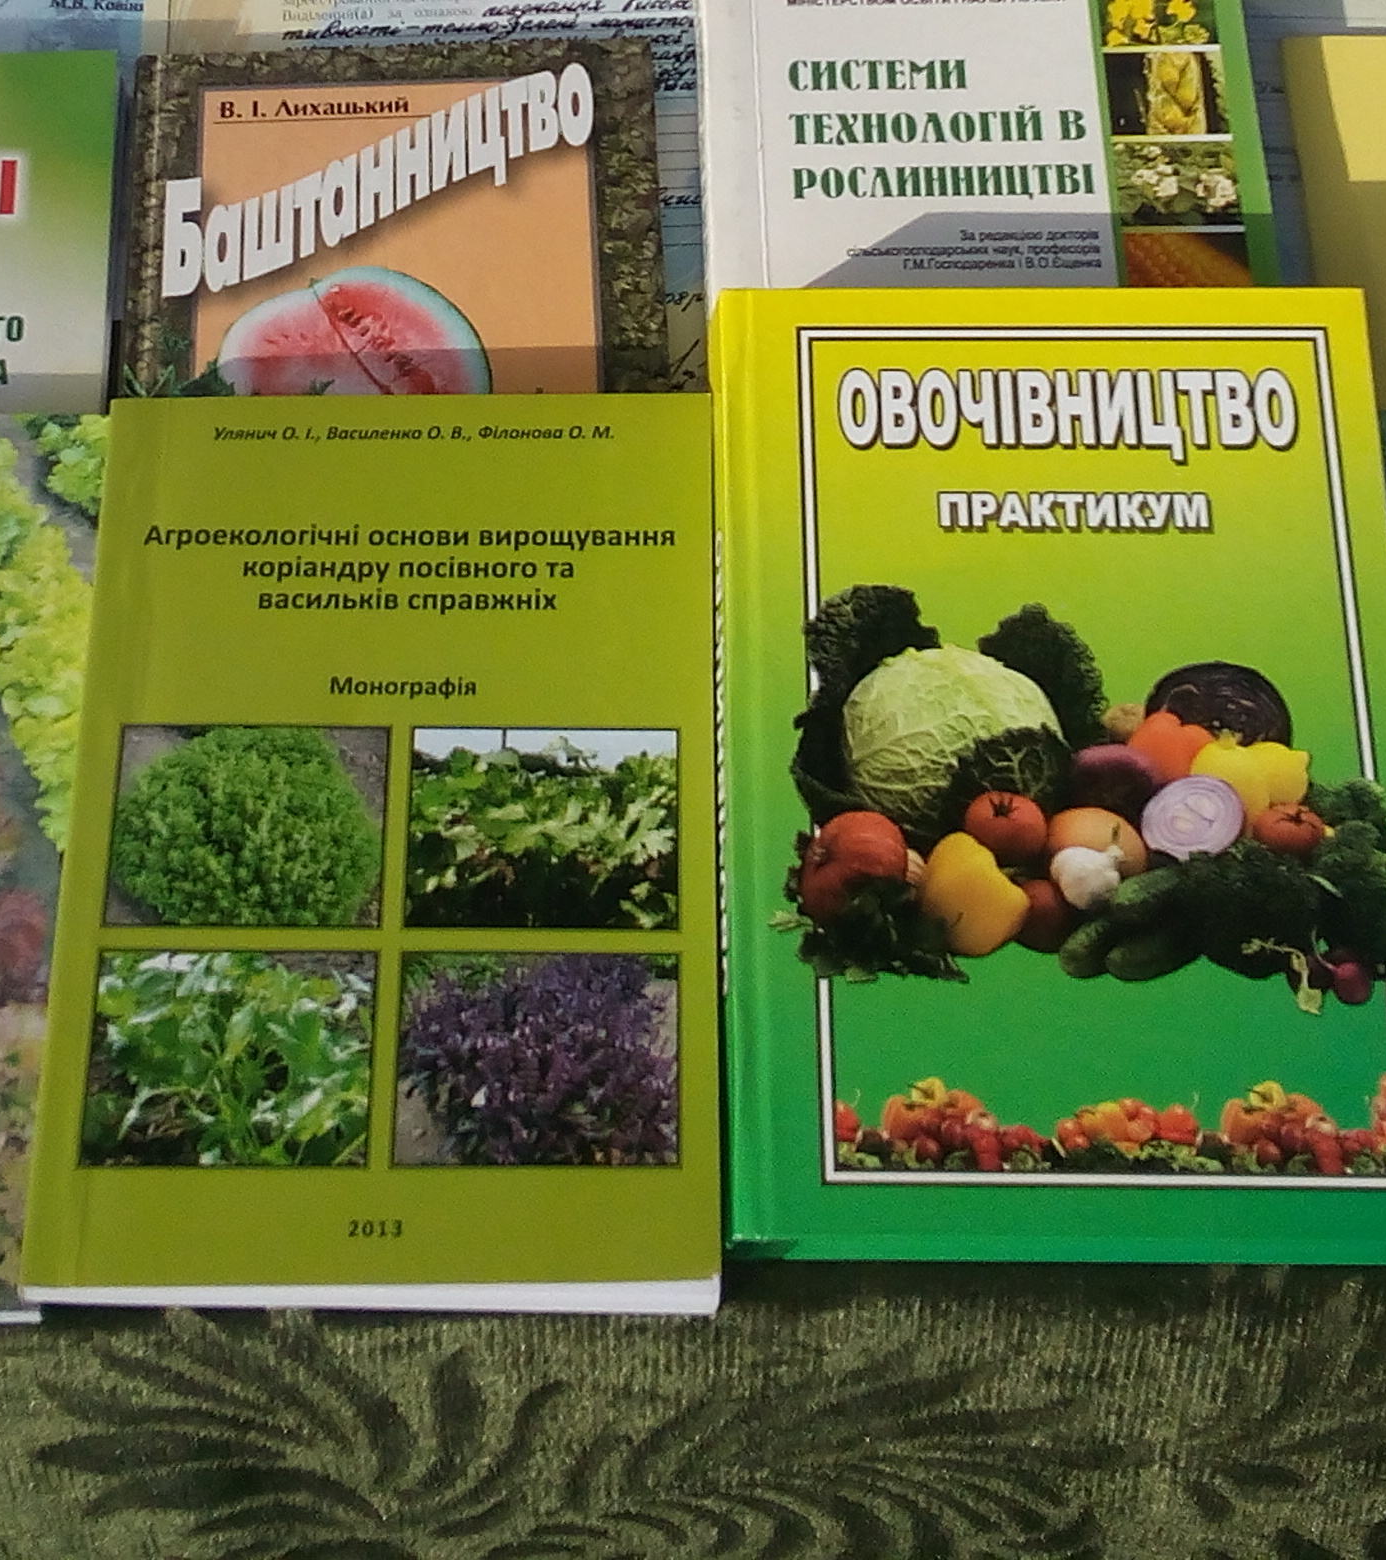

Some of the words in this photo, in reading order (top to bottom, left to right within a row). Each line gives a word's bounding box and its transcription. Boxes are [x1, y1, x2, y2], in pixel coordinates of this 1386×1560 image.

[787, 57, 968, 92] СИСТЕМИ
[273, 95, 411, 120] Лихацький
[790, 104, 1045, 146] ТЕХНОЛОГІЙ
[1060, 109, 1087, 141] В
[161, 62, 595, 298] Баштанництво
[792, 162, 1096, 202] РОСЛИННИЦТВІ
[837, 368, 1299, 465] ОВОЧІВНИЦТВО
[213, 425, 277, 441] Улянич
[326, 425, 422, 441] Василенко
[478, 424, 564, 443] Філонова
[938, 491, 1213, 533] ПРАКТИКУМ
[143, 523, 360, 552] Агроекологічні
[367, 529, 470, 547] основи
[478, 529, 676, 551] вирощування
[242, 555, 390, 585] коріандру
[398, 555, 539, 580] посівного
[545, 561, 575, 580] та
[258, 588, 400, 611] васильків
[408, 587, 559, 617] справжніх
[329, 674, 478, 701] Монографія
[347, 1218, 404, 1238] 2013
